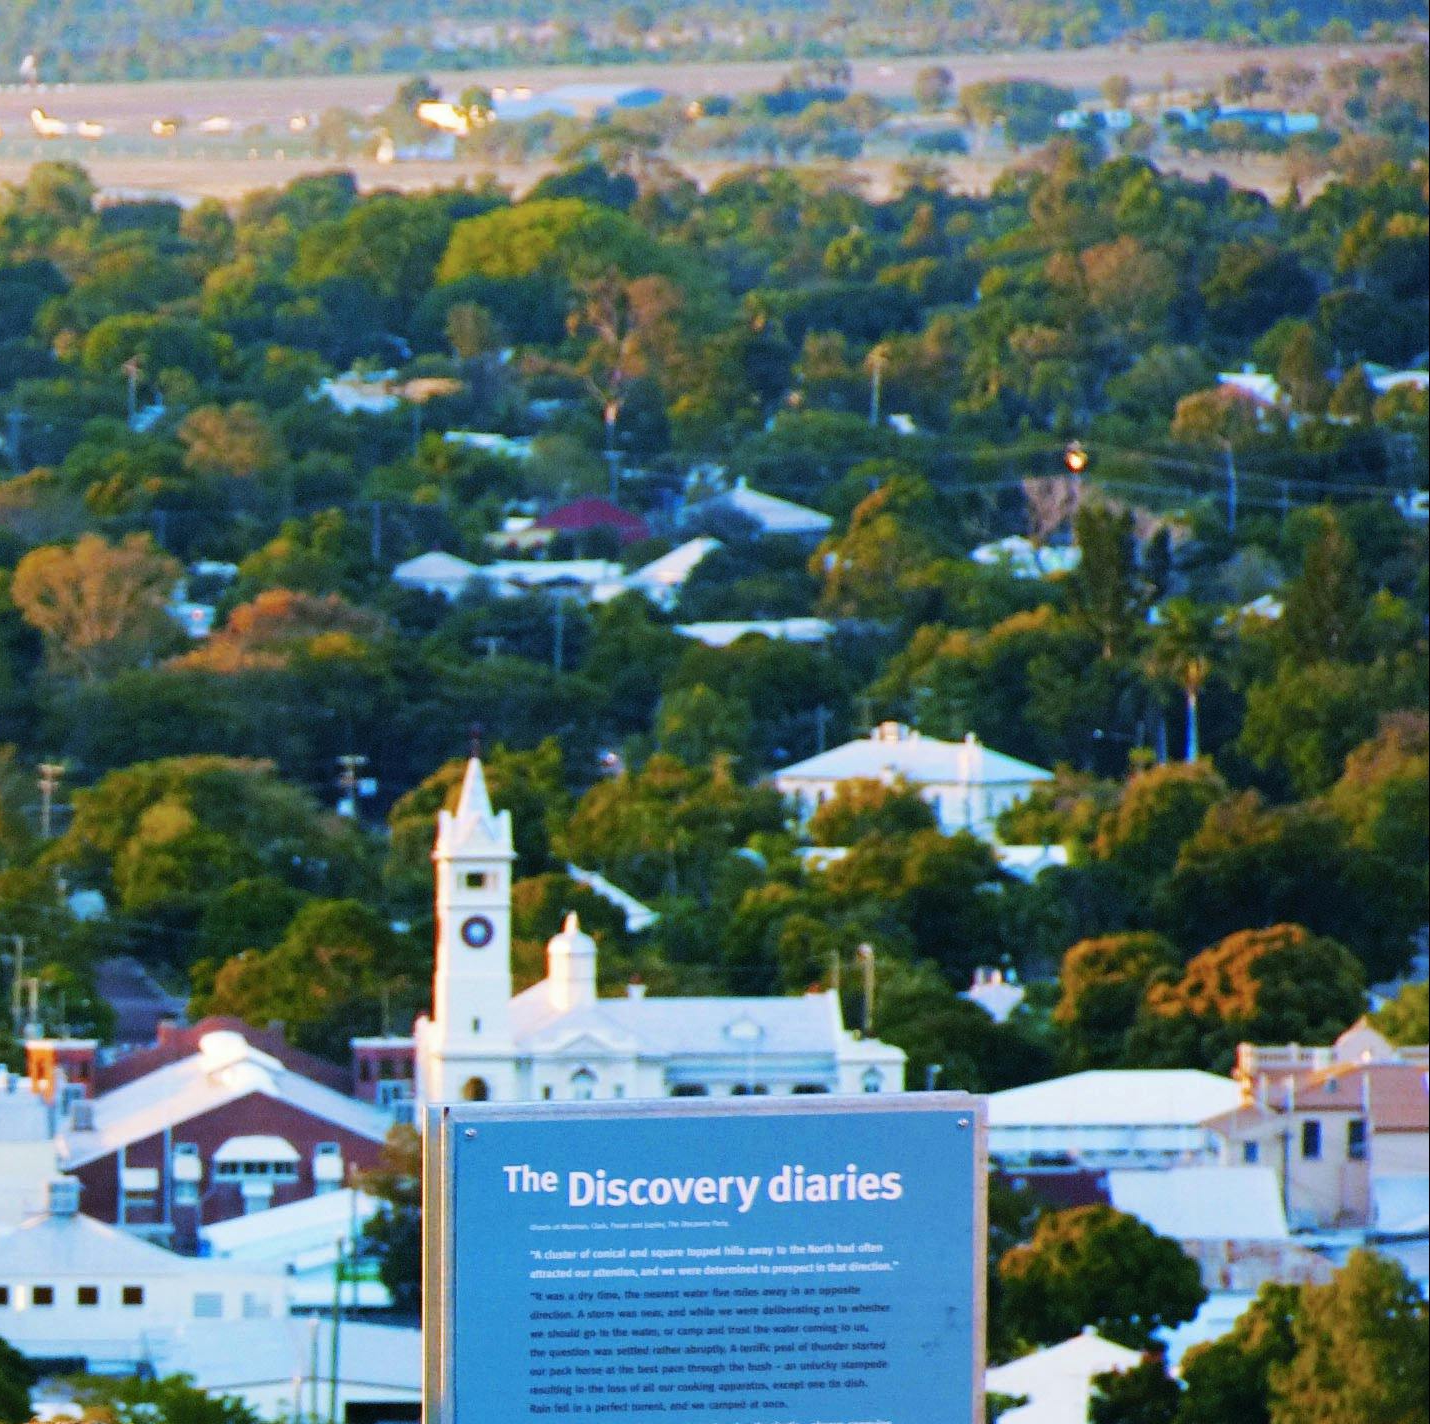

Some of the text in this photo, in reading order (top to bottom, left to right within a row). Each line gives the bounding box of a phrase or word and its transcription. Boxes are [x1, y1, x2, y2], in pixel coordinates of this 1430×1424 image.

[503, 1164, 904, 1213] The Discovery diaries
[543, 1248, 577, 1259] cluster
[579, 1248, 590, 1258] of
[592, 1247, 626, 1258] conical
[628, 1246, 648, 1257] and
[650, 1248, 684, 1258] square
[686, 1245, 721, 1258] topped
[723, 1245, 745, 1255] hills
[747, 1247, 773, 1256] away
[776, 1245, 787, 1254] to
[789, 1243, 806, 1254] the
[806, 1243, 834, 1254] North
[835, 1243, 855, 1253] had
[857, 1242, 883, 1253] often
[529, 1267, 572, 1278] attracted
[573, 1269, 590, 1277] our
[640, 1265, 660, 1276] and
[660, 1267, 675, 1275] we
[677, 1267, 702, 1275] were
[703, 1263, 758, 1274] determined
[759, 1264, 770, 1273] to
[770, 1263, 814, 1275] prospect
[826, 1262, 847, 1272] that
[577, 1289, 593, 1301] dry
[624, 1289, 640, 1298] the
[643, 1289, 679, 1298] nearest
[682, 1288, 708, 1297] water
[712, 1287, 730, 1296] five
[732, 1286, 759, 1296] miles
[761, 1288, 787, 1297] away
[818, 1285, 860, 1296] opposite
[529, 1309, 572, 1319] direction.
[586, 1309, 614, 1318] storm
[667, 1307, 686, 1316] and
[688, 1306, 715, 1316] while
[762, 1304, 820, 1316] deliberating
[851, 1303, 890, 1313] whether
[547, 1328, 580, 1337] should
[611, 1327, 628, 1336] the
[676, 1328, 703, 1337] camp
[706, 1325, 724, 1334] and
[753, 1324, 770, 1334] the
[772, 1325, 799, 1333] water
[802, 1324, 837, 1334] coming
[529, 1347, 546, 1356] the
[548, 1347, 590, 1358] question
[616, 1345, 649, 1355] settled
[652, 1344, 681, 1354] rather
[739, 1343, 770, 1352] terrific
[810, 1341, 848, 1351] thunder
[851, 1340, 886, 1350] started
[548, 1365, 571, 1376] pack
[575, 1364, 602, 1374] horse
[618, 1364, 634, 1373] the
[637, 1363, 658, 1373] best
[661, 1365, 684, 1374] pace
[687, 1362, 725, 1374] through
[728, 1362, 744, 1371] the
[747, 1361, 772, 1371] bush
[840, 1359, 887, 1371] stampede
[529, 1384, 572, 1396] resulting
[587, 1383, 603, 1393] the
[607, 1383, 627, 1392] loss
[642, 1382, 654, 1392] all
[677, 1381, 714, 1393] cooking
[772, 1380, 804, 1391] except
[529, 1403, 551, 1413] Rain
[553, 1403, 569, 1412] fell
[594, 1402, 627, 1413] perfect
[669, 1401, 688, 1410] and
[708, 1400, 746, 1411] camped
